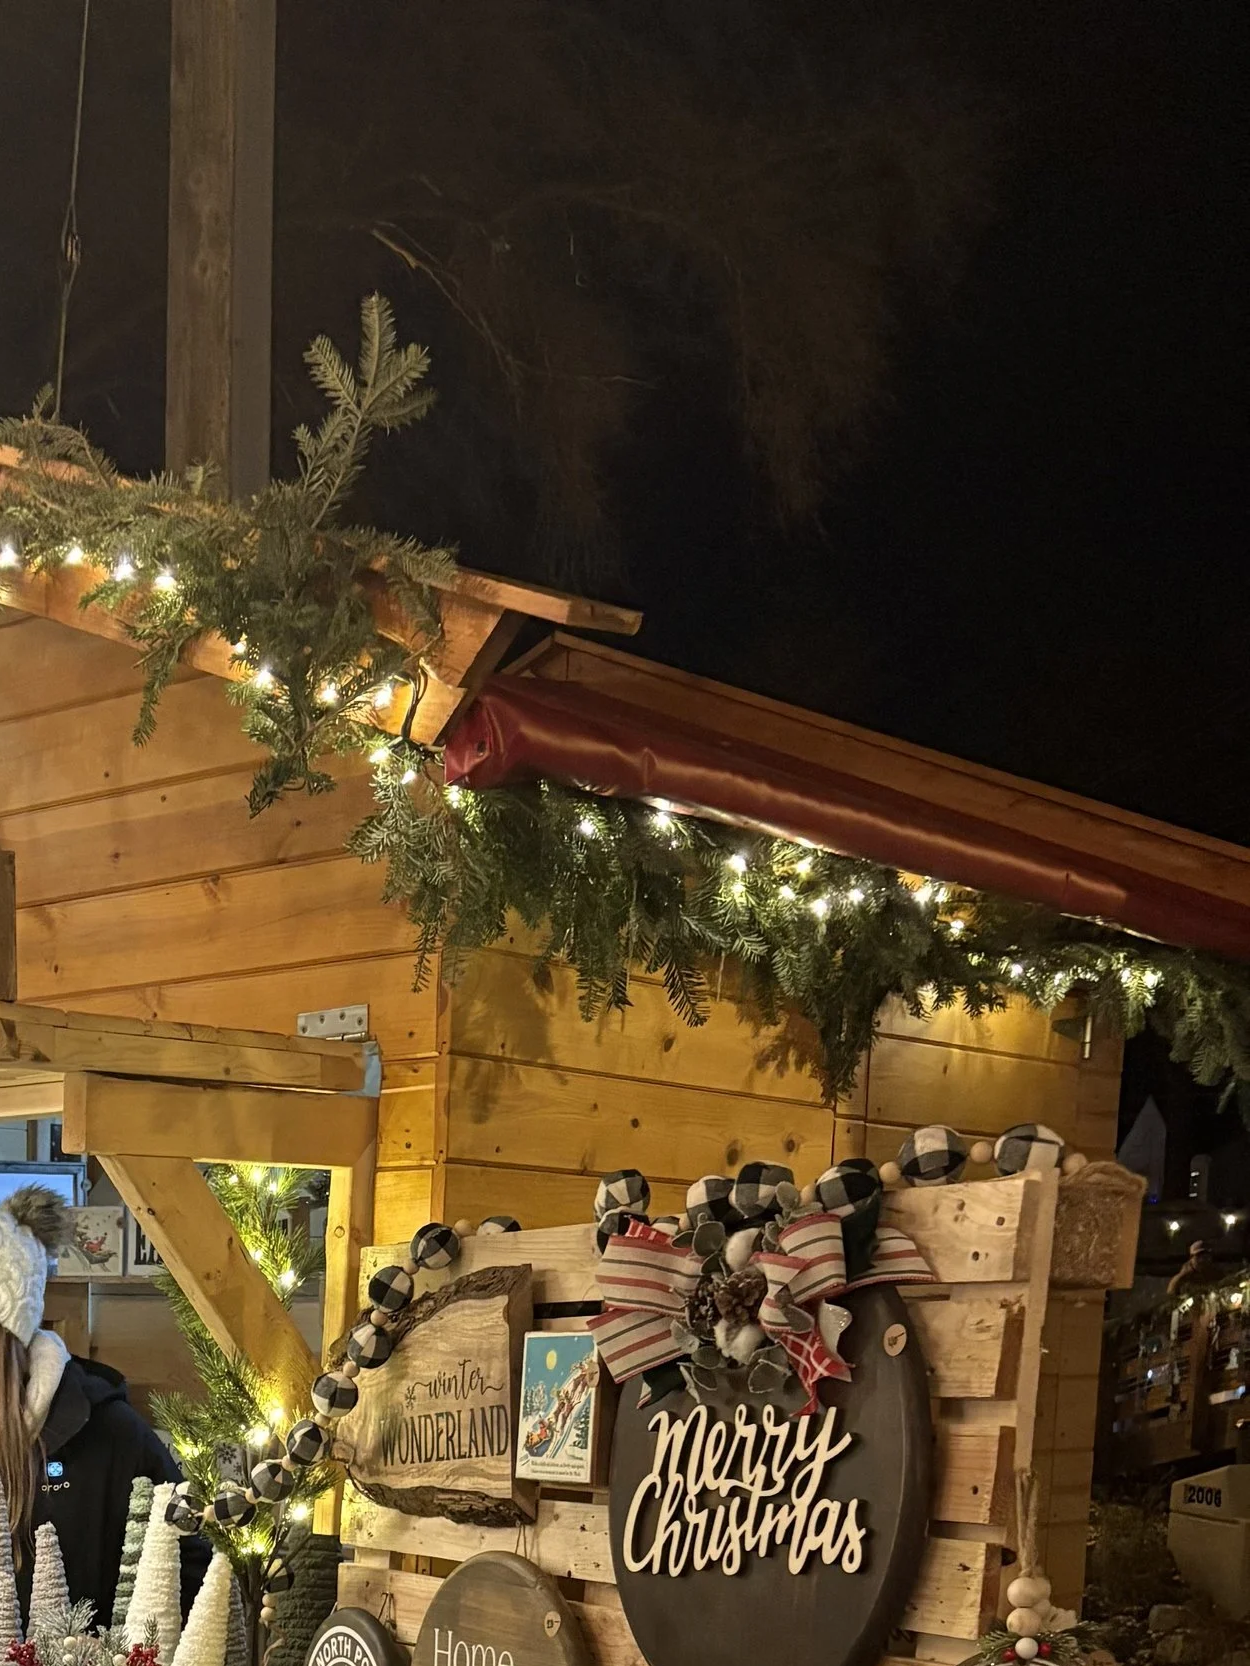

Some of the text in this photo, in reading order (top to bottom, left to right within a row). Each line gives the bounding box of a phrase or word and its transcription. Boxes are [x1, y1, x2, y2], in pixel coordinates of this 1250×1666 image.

[412, 1359, 504, 1401] winter
[381, 1404, 509, 1467] WONDERLAND
[648, 1404, 852, 1500] Merry
[623, 1464, 867, 1577] Christmas
